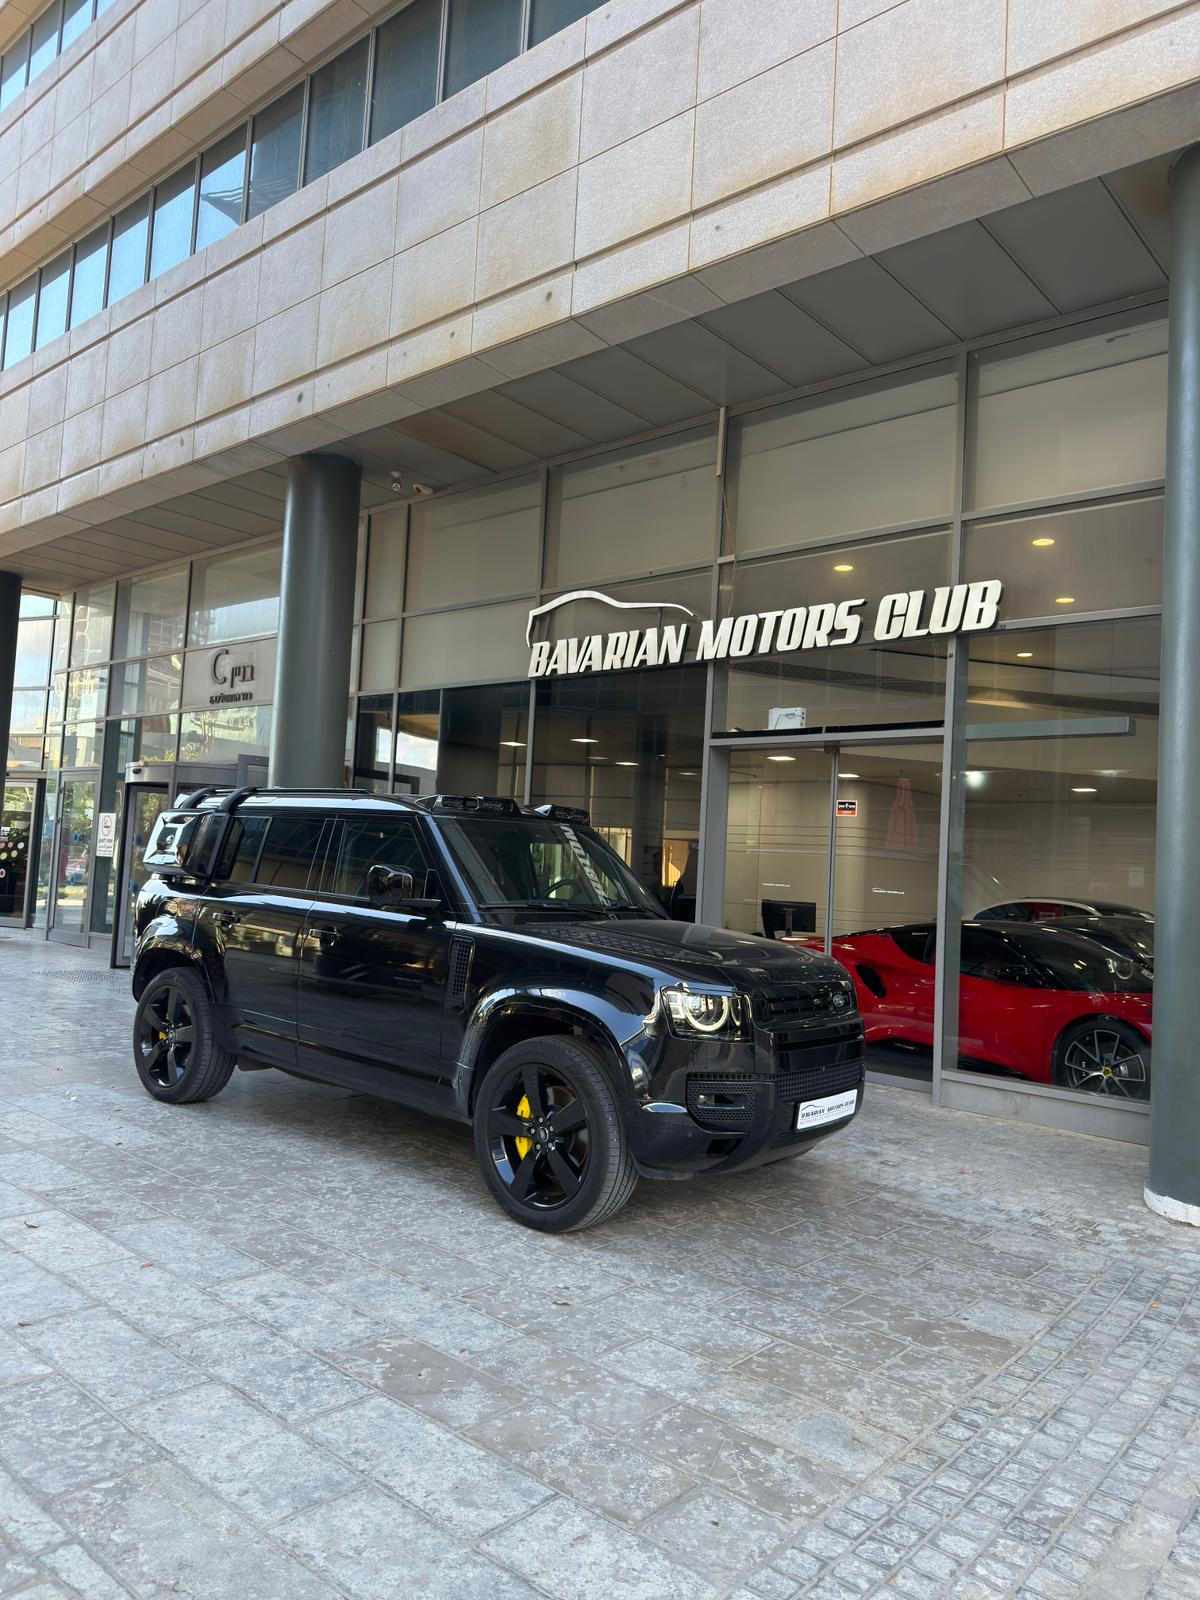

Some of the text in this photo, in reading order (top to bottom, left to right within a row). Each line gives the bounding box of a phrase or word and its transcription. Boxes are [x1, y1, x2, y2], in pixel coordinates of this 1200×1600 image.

[527, 579, 1004, 678] BAVARIAN MOTORS CLUB
